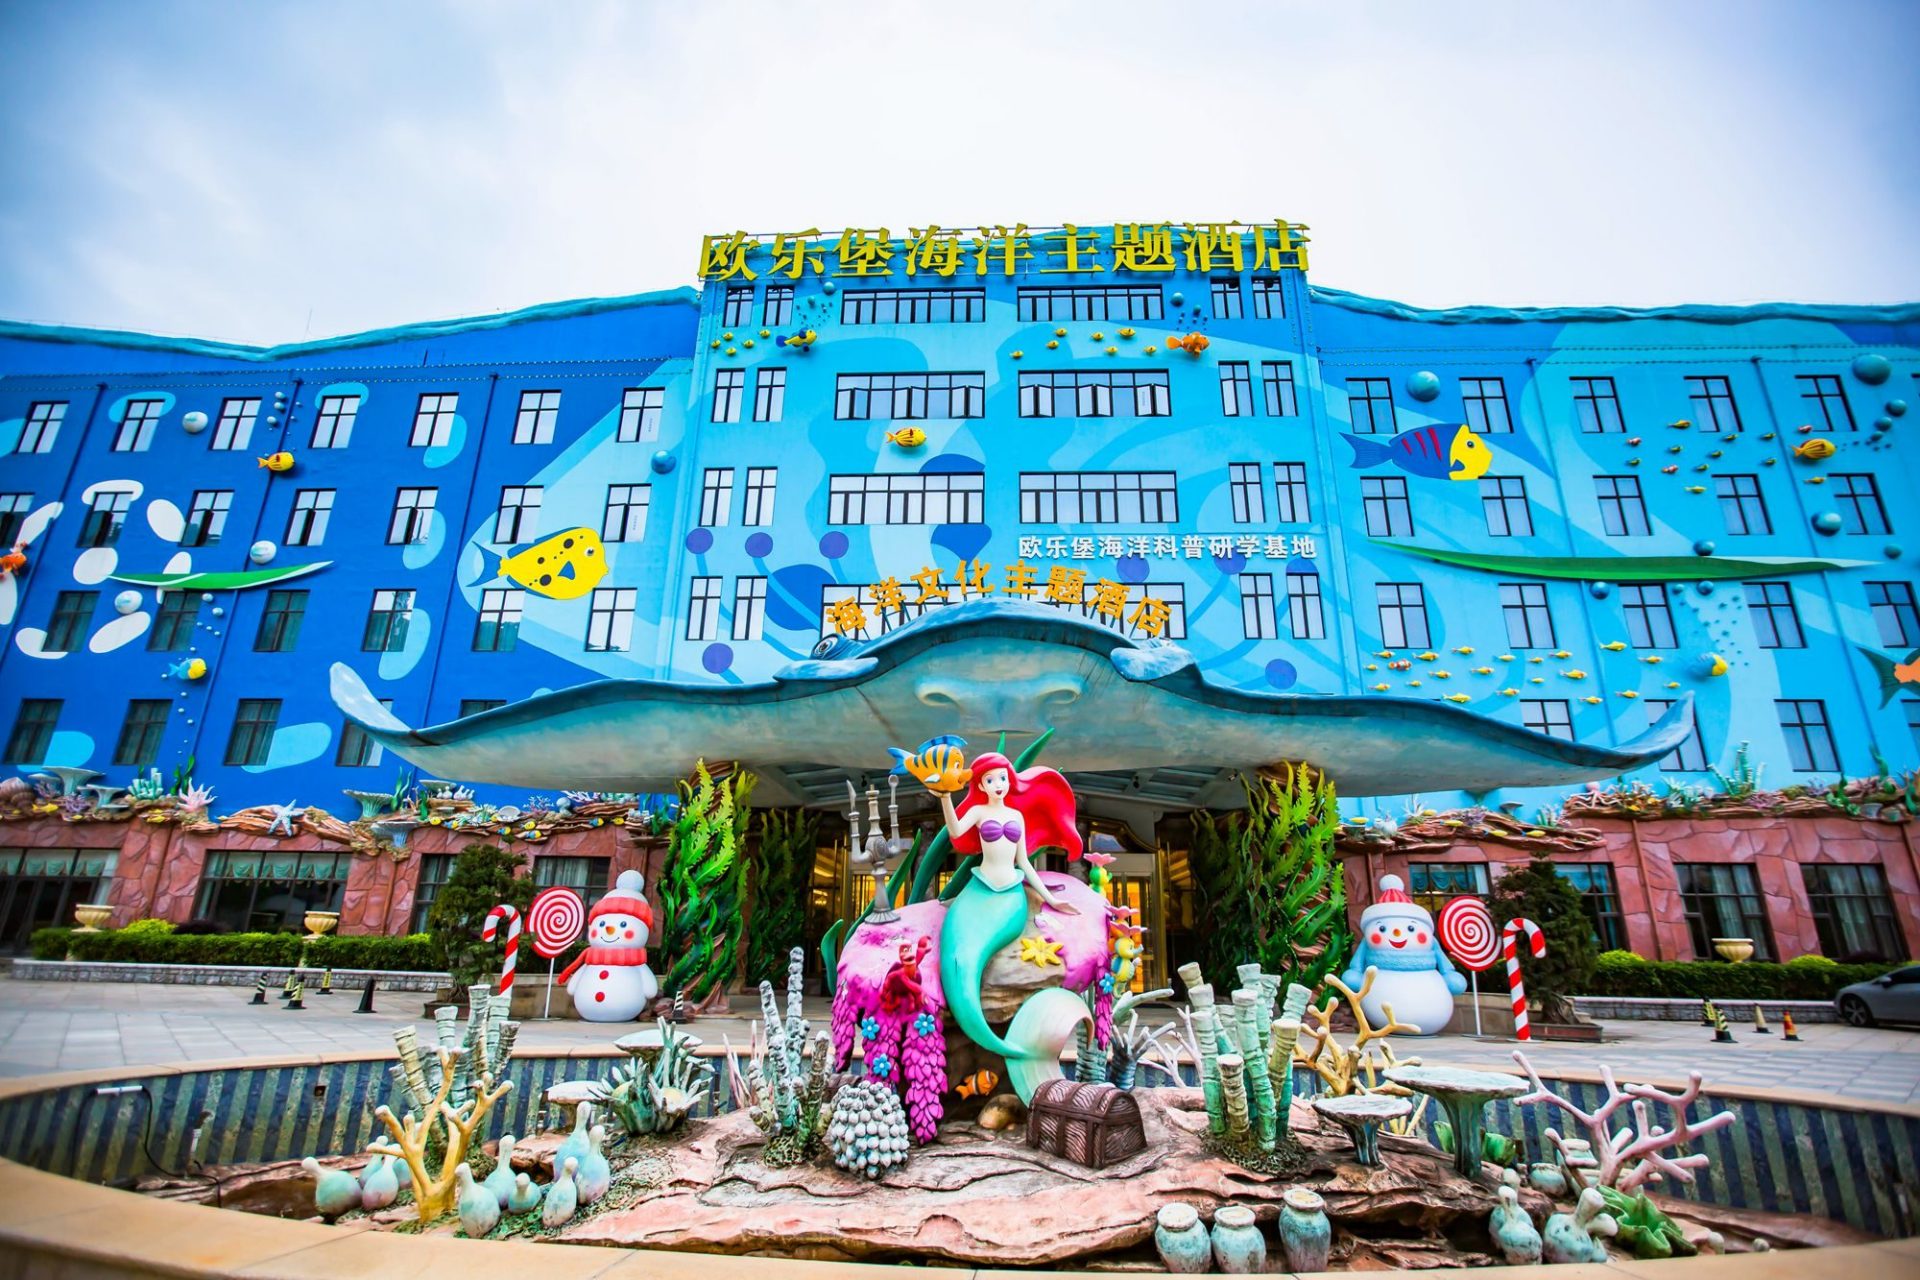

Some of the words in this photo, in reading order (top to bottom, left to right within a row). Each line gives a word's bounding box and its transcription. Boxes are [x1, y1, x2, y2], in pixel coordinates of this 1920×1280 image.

[697, 218, 1311, 282] 欧乐堡海洋主题酒店
[1018, 535, 1318, 559] 欧乐堡海洋科普研学基地
[826, 559, 1172, 637] 海洋文化主题酒店
